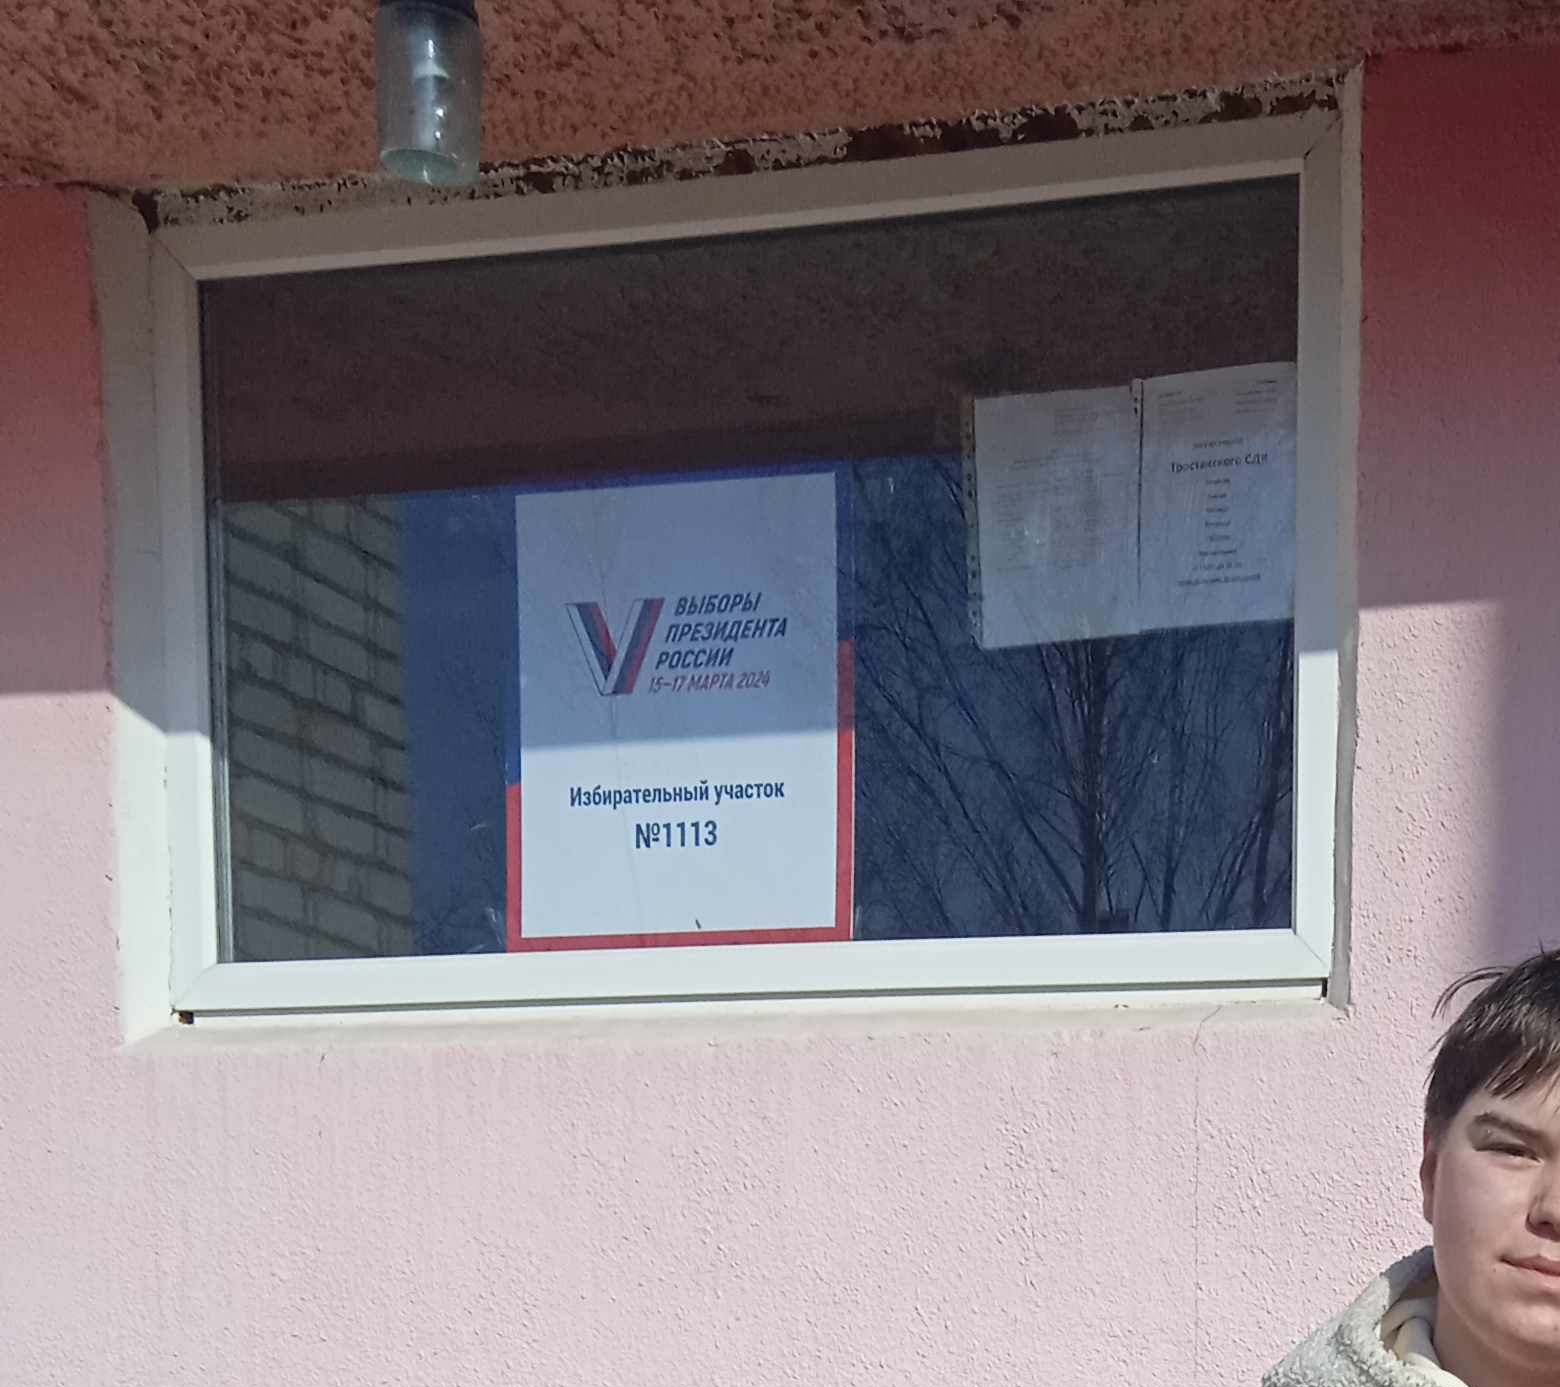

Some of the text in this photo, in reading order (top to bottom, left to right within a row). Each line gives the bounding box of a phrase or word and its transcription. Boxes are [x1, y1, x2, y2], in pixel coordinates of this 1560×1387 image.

[674, 592, 762, 616] ВЫБОРЫ
[664, 617, 788, 644] ПРЕЗИДЕНТА
[655, 647, 734, 670] РОССИИ
[687, 673, 735, 692] МАРТА
[736, 671, 771, 688] 2024
[569, 780, 785, 811] Избирательный участок
[635, 820, 718, 849] №1113
